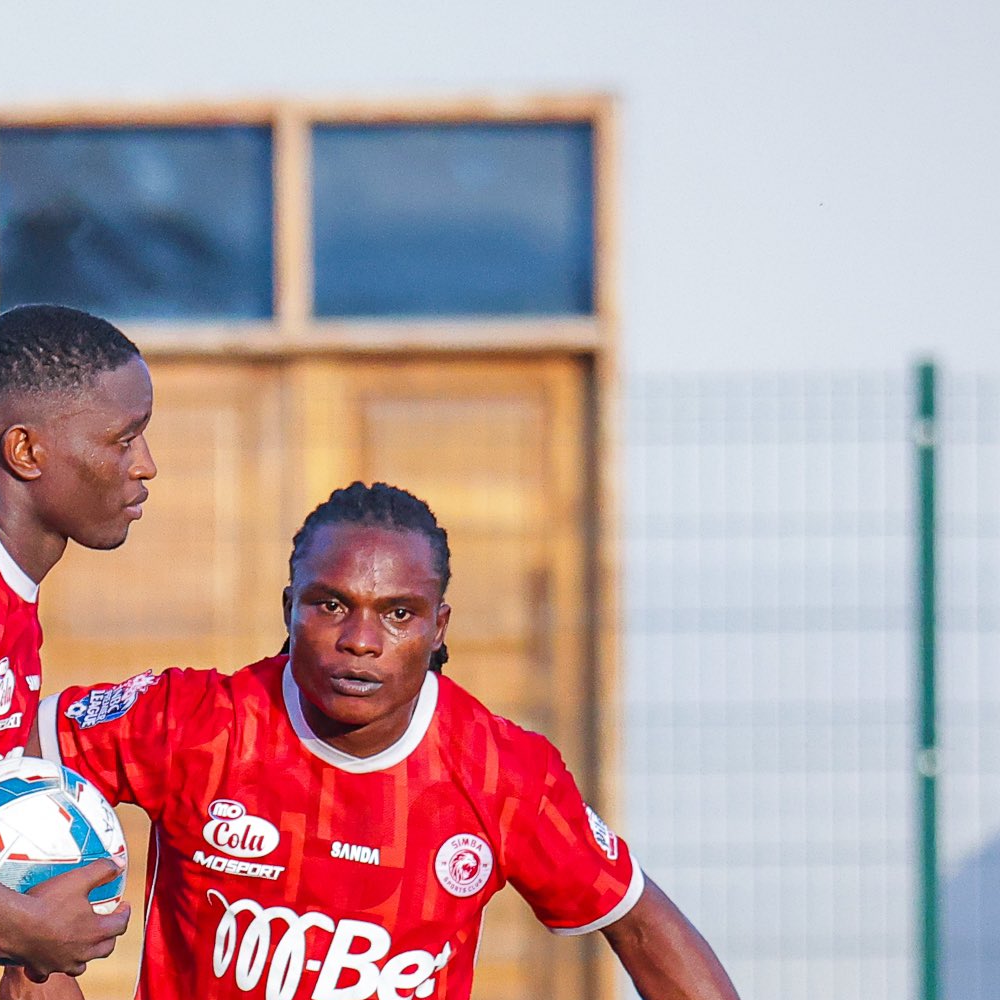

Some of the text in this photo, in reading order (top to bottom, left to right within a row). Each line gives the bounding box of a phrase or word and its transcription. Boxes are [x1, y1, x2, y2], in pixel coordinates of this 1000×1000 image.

[213, 822, 265, 851] Cola
[451, 838, 483, 851] SIMBA
[192, 850, 285, 880] MOSPORT
[331, 841, 380, 865] SANDA
[444, 877, 466, 893] SPORTS
